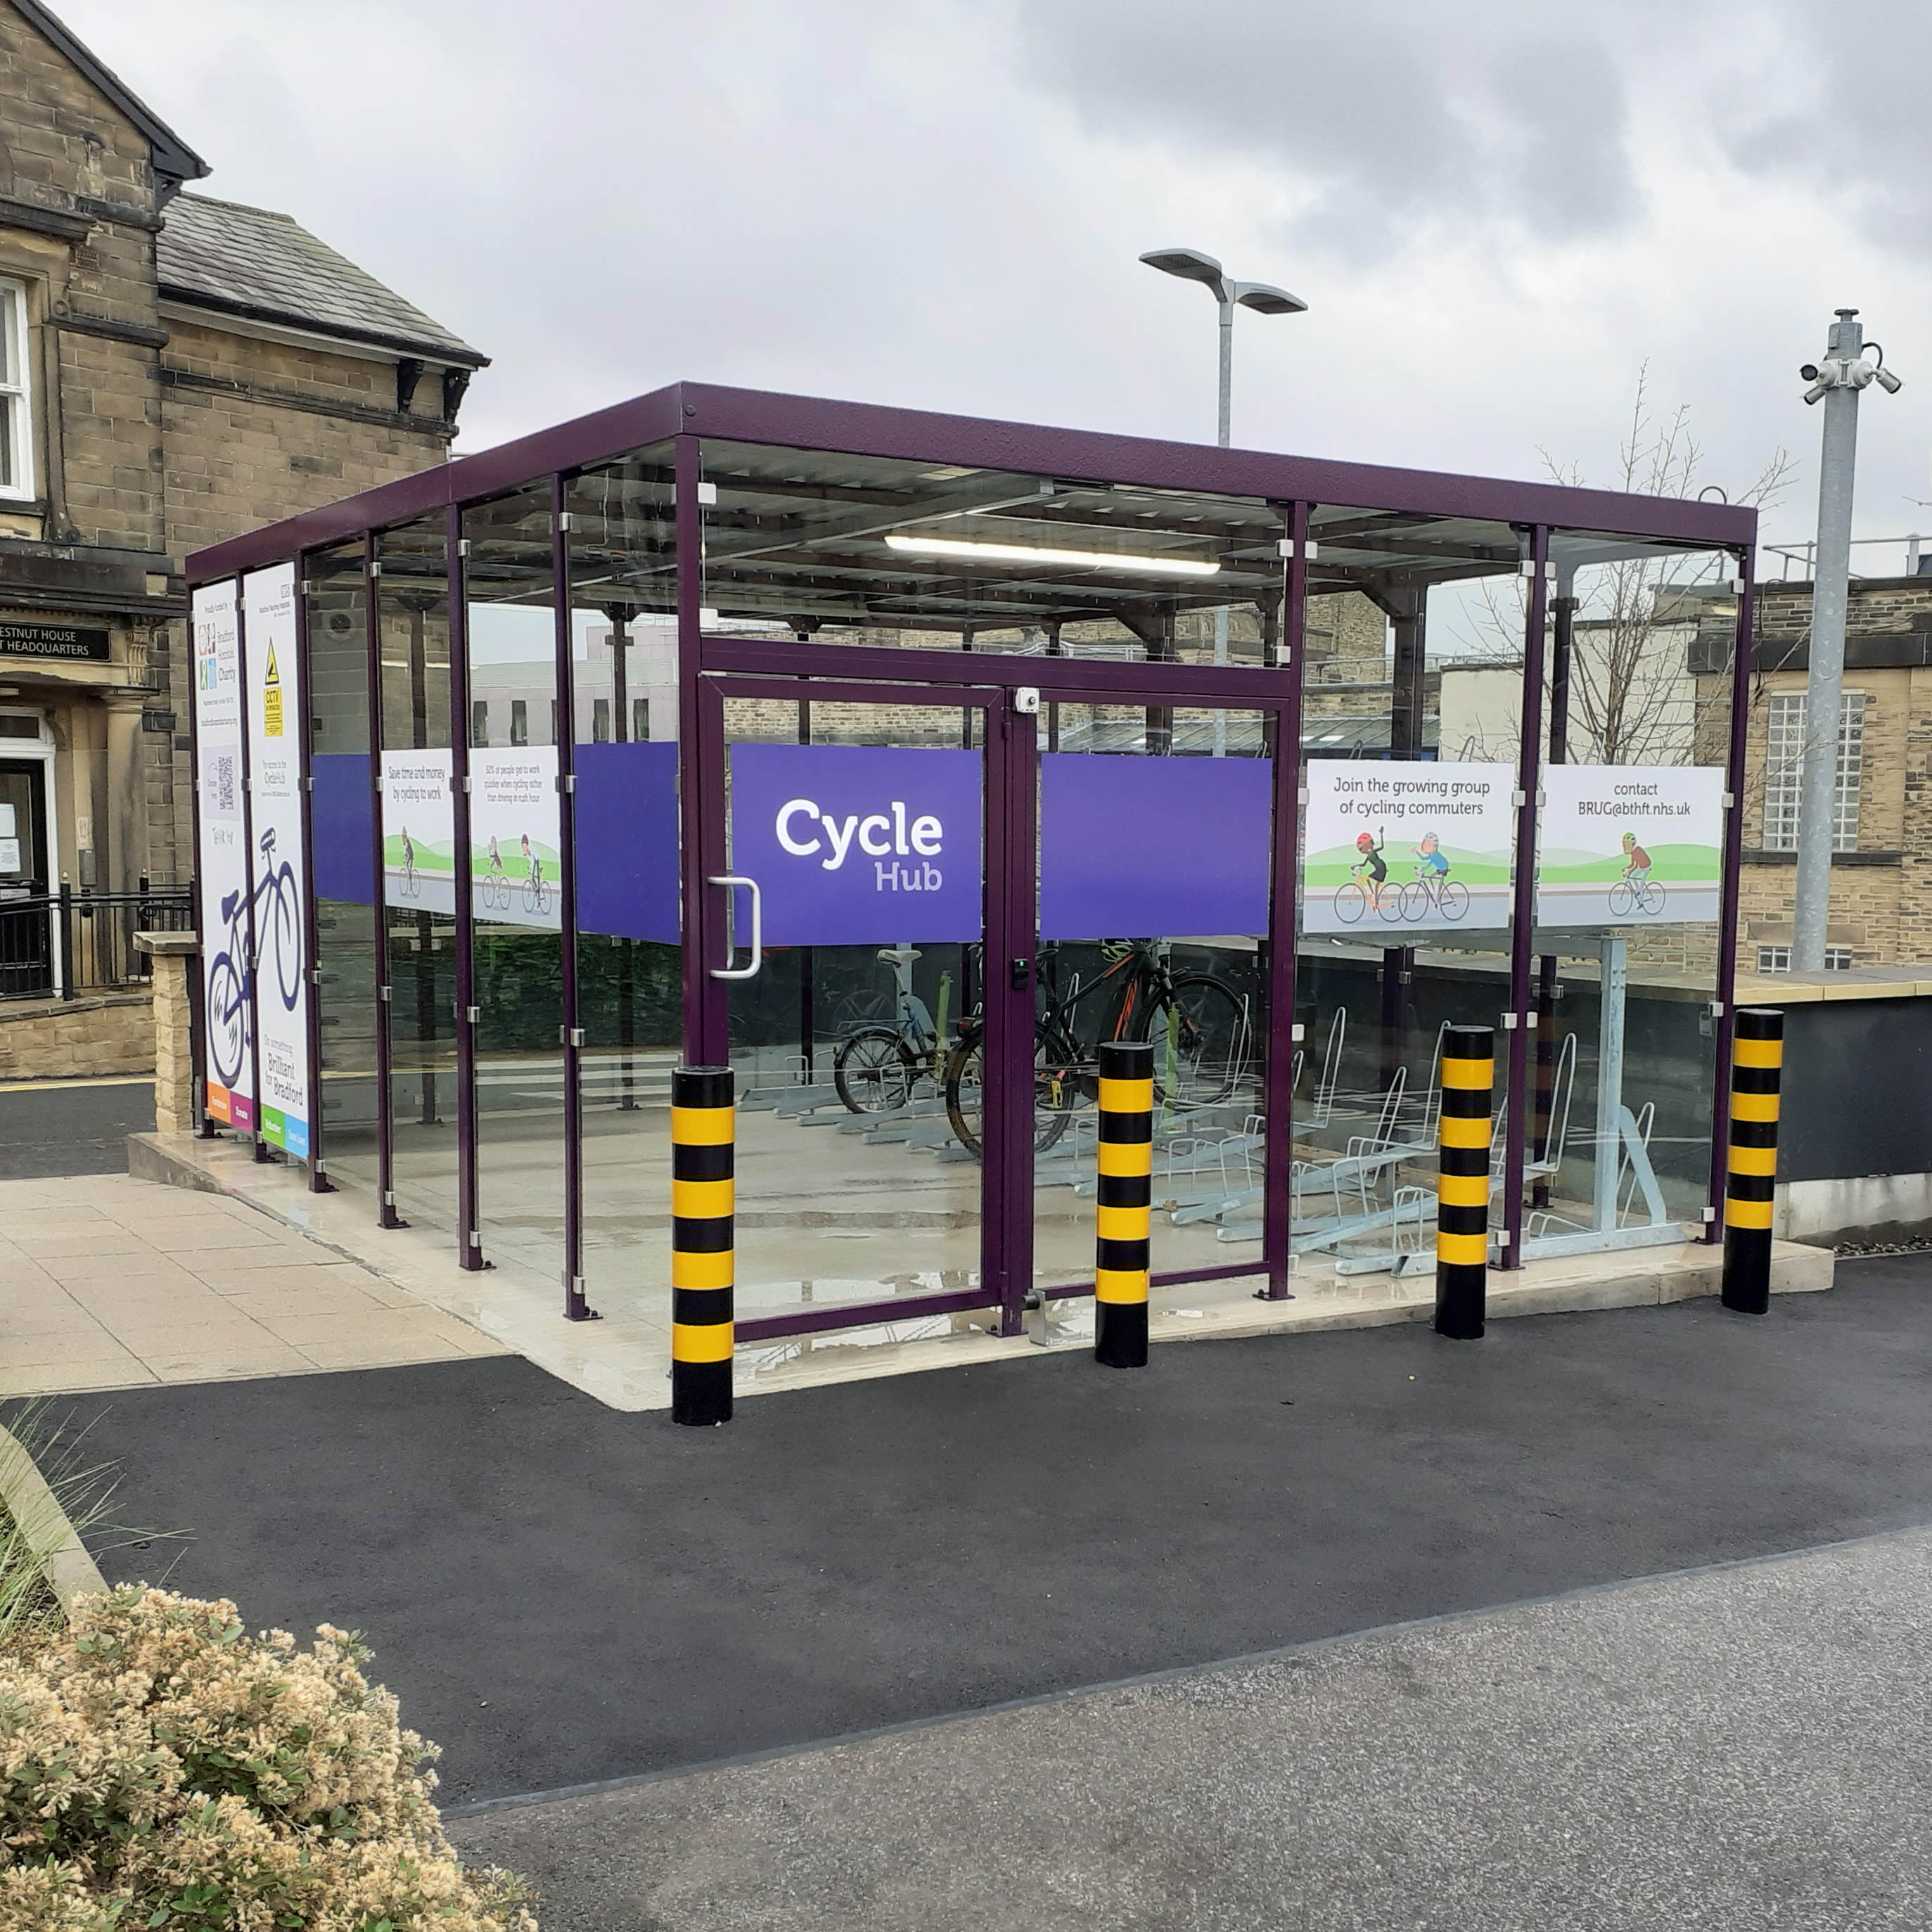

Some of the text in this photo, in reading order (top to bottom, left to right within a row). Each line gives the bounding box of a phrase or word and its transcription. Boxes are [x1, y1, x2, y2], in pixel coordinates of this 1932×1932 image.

[41, 629, 77, 641] HOUSE
[7, 641, 89, 655] HEADQUARTERS
[388, 765, 445, 783] Save time and money
[501, 765, 515, 776] people
[523, 765, 529, 774] to
[529, 765, 540, 774] work
[392, 785, 442, 802] by cycling to work
[1333, 777, 1490, 798] Join the growing group
[1614, 783, 1658, 795] contact
[1339, 799, 1483, 818] of cycling commuters
[1578, 801, 1691, 817] BRUG@bthft.nhs.uk
[776, 798, 943, 871] Cycle
[874, 861, 943, 892] Hub
[268, 1052, 295, 1081] Brilliant
[274, 1076, 304, 1107] Bradford
